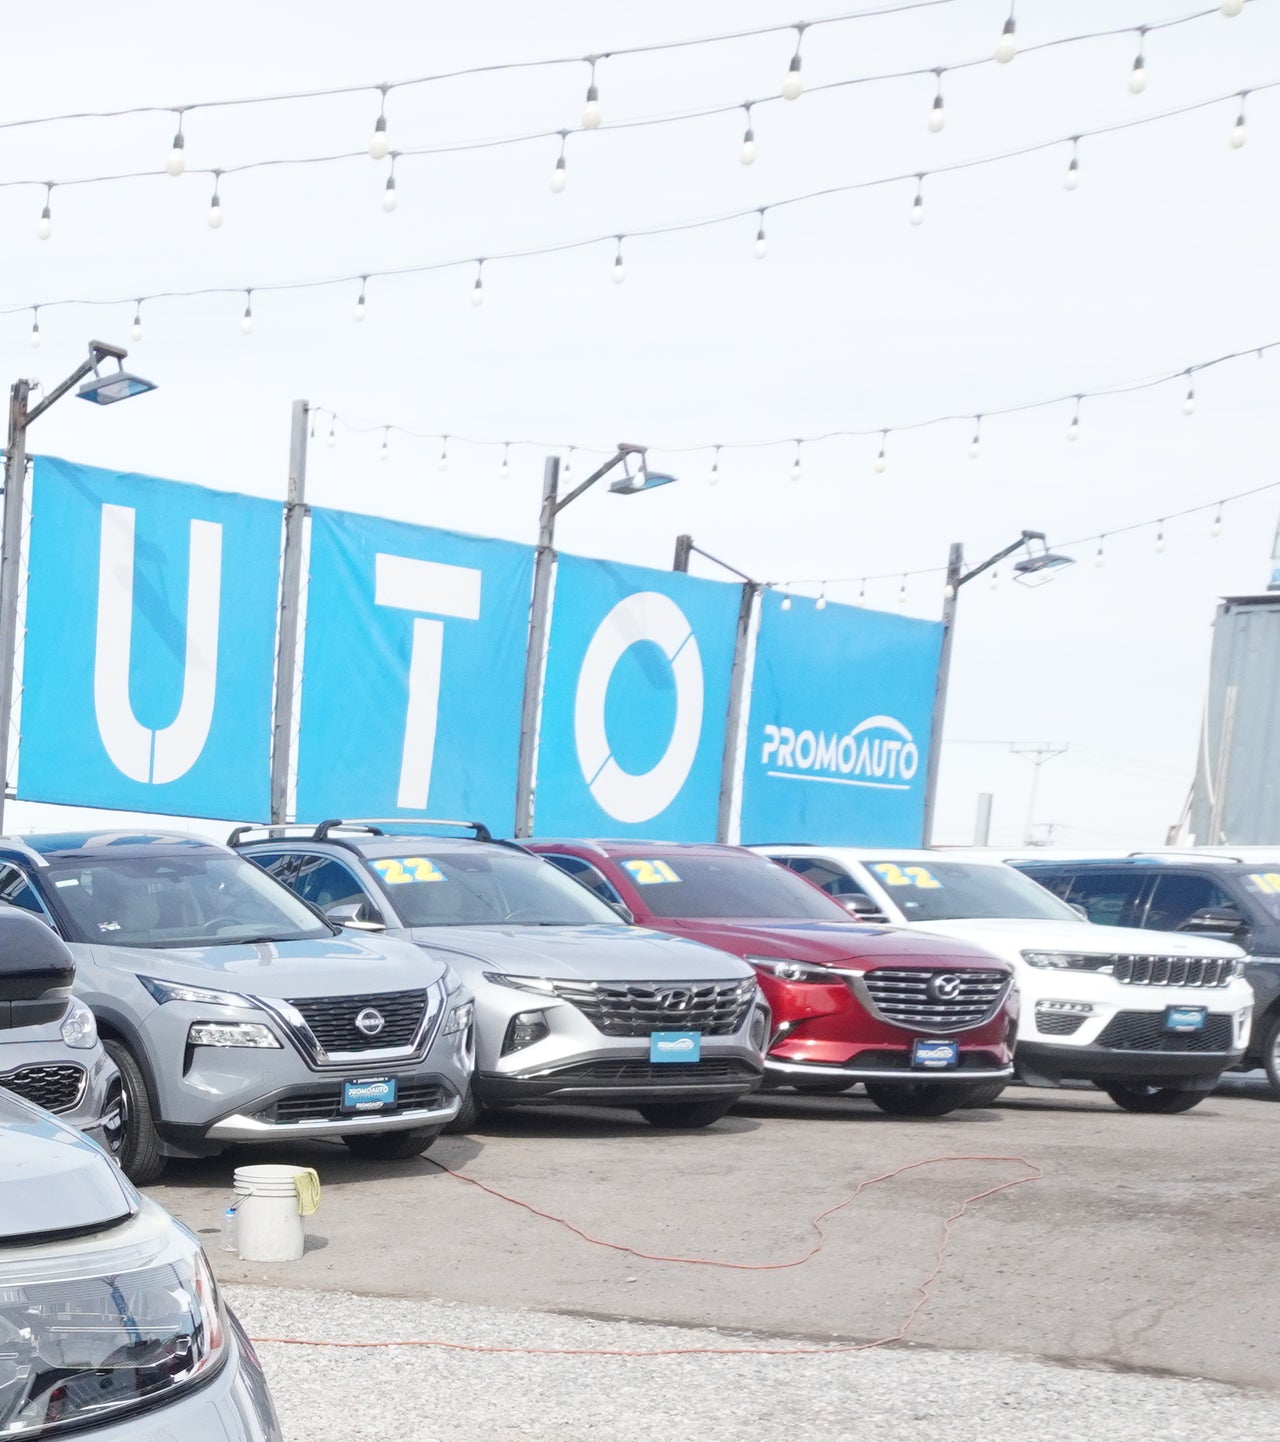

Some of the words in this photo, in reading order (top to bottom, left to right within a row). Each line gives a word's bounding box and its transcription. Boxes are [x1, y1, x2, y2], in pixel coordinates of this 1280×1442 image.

[761, 723, 919, 781] PROMOAUTO
[374, 857, 443, 885] 22
[625, 859, 682, 885] 21
[874, 862, 941, 889] 22
